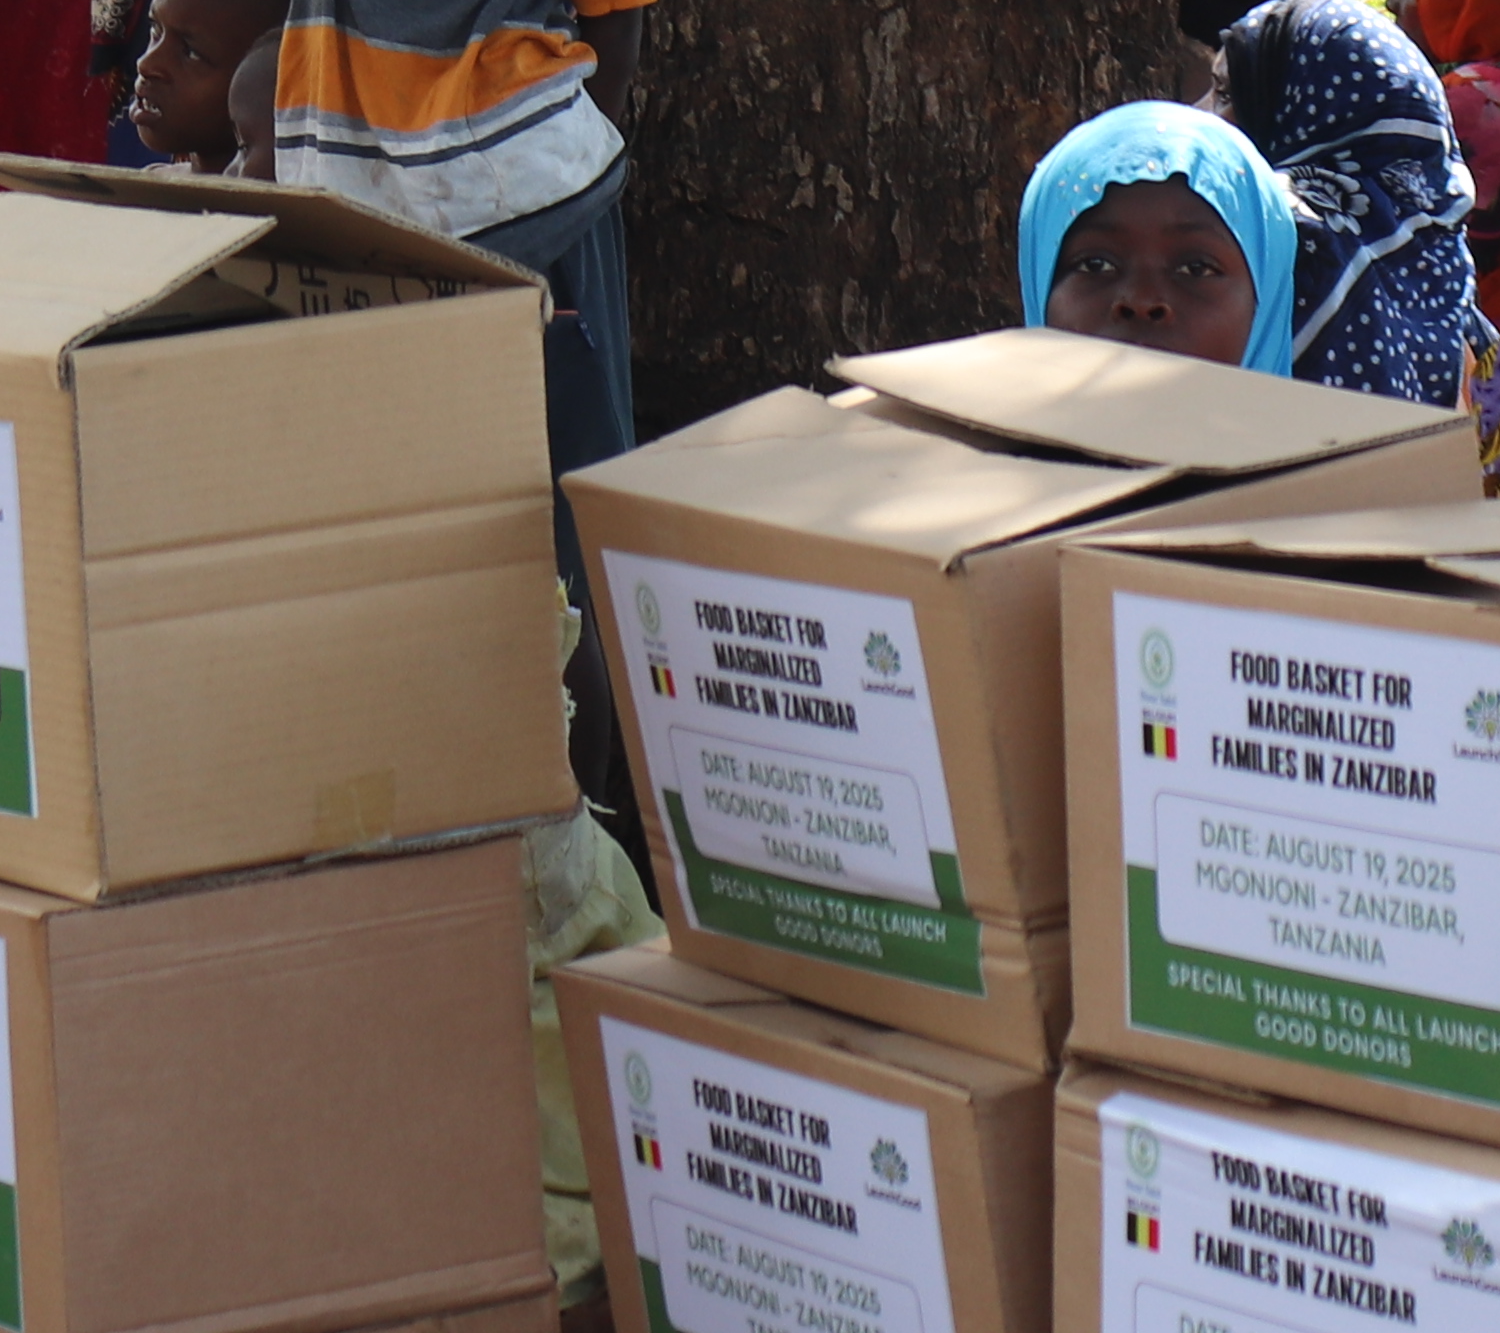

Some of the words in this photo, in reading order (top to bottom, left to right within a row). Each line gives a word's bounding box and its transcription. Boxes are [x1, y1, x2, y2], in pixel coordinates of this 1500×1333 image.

[1231, 650, 1280, 688] FOOD
[1286, 659, 1364, 701] BASKET
[1371, 672, 1411, 709] FOR
[1247, 697, 1395, 752] MARGINALIZED
[1212, 735, 1298, 781] FAMILIES
[1305, 751, 1325, 785] IN
[1332, 755, 1437, 803] ZANZIBAR
[1200, 819, 1259, 857] DATE:
[1266, 833, 1358, 875] AUGUST
[1364, 851, 1390, 889] 19,
[1397, 856, 1456, 894] 2025
[1195, 861, 1316, 910] MGONJONI
[1338, 888, 1465, 945] ZANZIBAR,
[1268, 917, 1386, 967] TANZANIA
[1168, 962, 1246, 1001] SPECIAL
[1251, 981, 1331, 1019] THANKS
[1337, 999, 1366, 1026] TO
[1372, 1008, 1410, 1036] ALL
[1255, 1013, 1317, 1046] GOOD
[1323, 1027, 1410, 1068] DONORS
